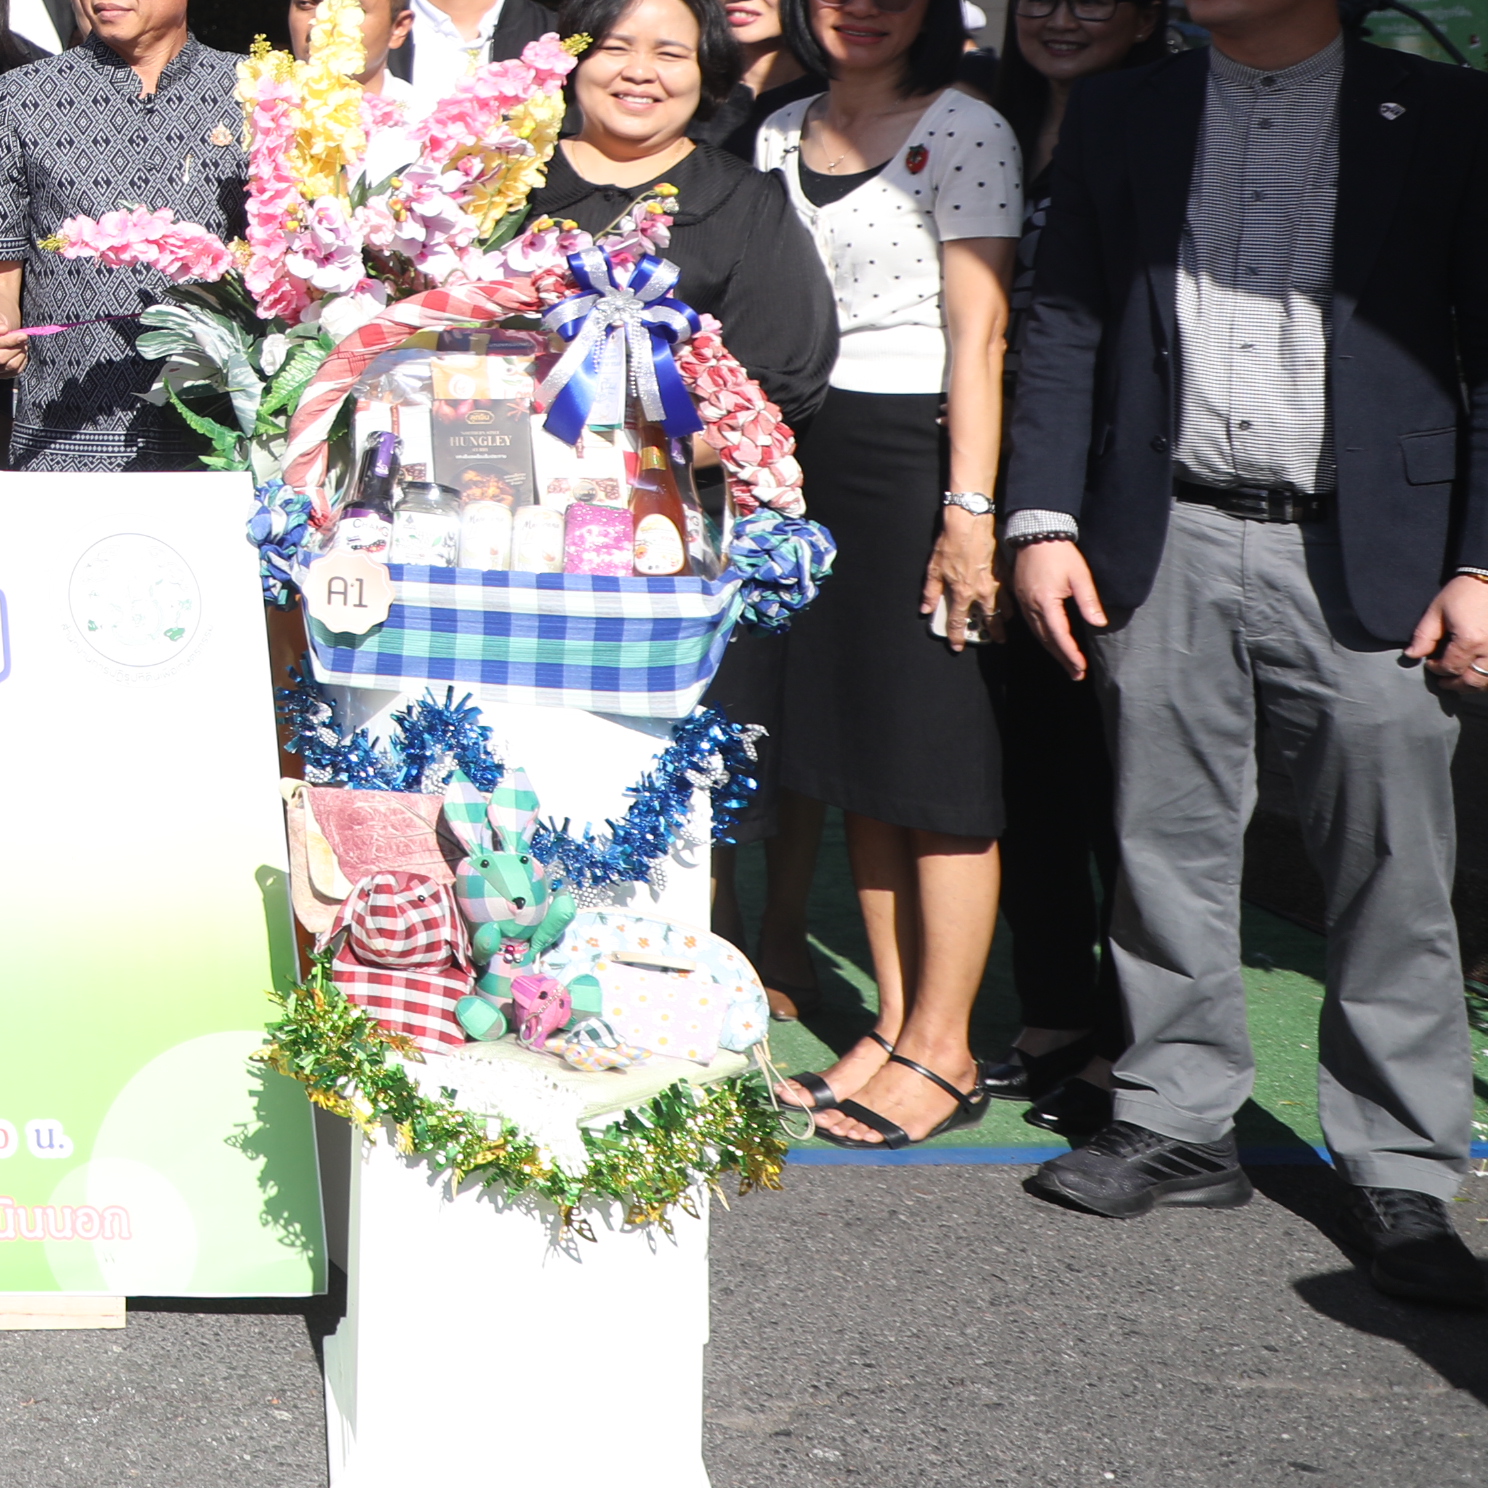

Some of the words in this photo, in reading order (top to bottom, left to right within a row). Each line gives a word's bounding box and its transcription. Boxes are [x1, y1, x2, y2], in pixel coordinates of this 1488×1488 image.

[449, 435, 512, 446] HUNGLEY
[327, 575, 369, 609] A1
[34, 1125, 66, 1152] น.
